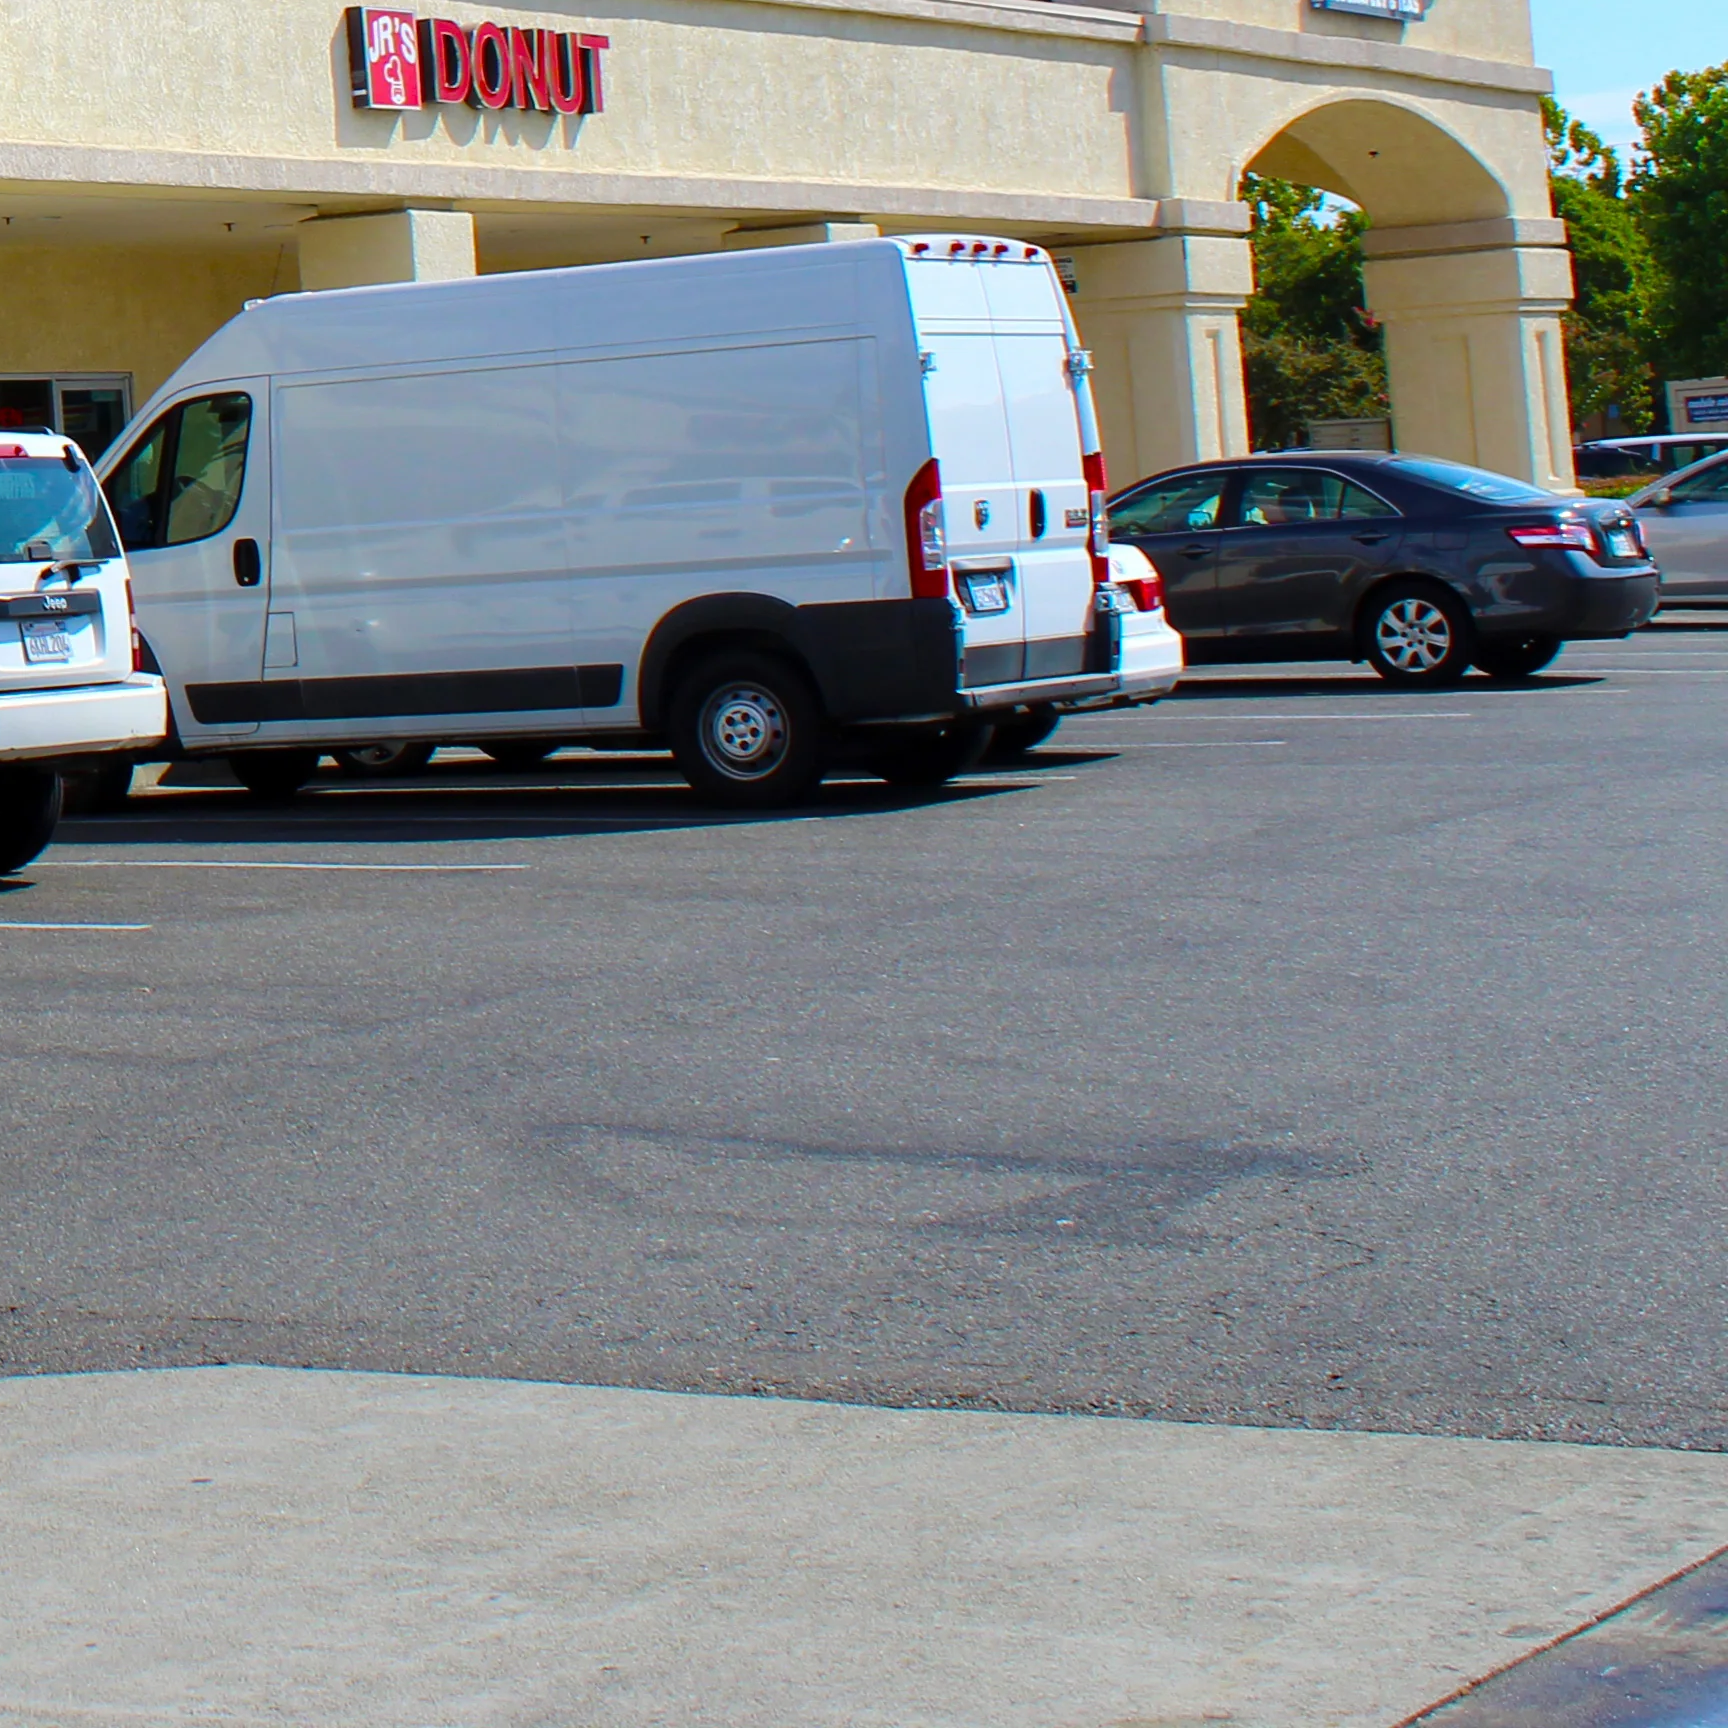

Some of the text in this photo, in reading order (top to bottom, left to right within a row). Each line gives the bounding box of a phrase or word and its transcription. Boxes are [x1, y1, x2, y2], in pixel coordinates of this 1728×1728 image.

[369, 15, 417, 65] JR'S
[424, 18, 610, 115] DONUT
[43, 595, 67, 611] Jeep
